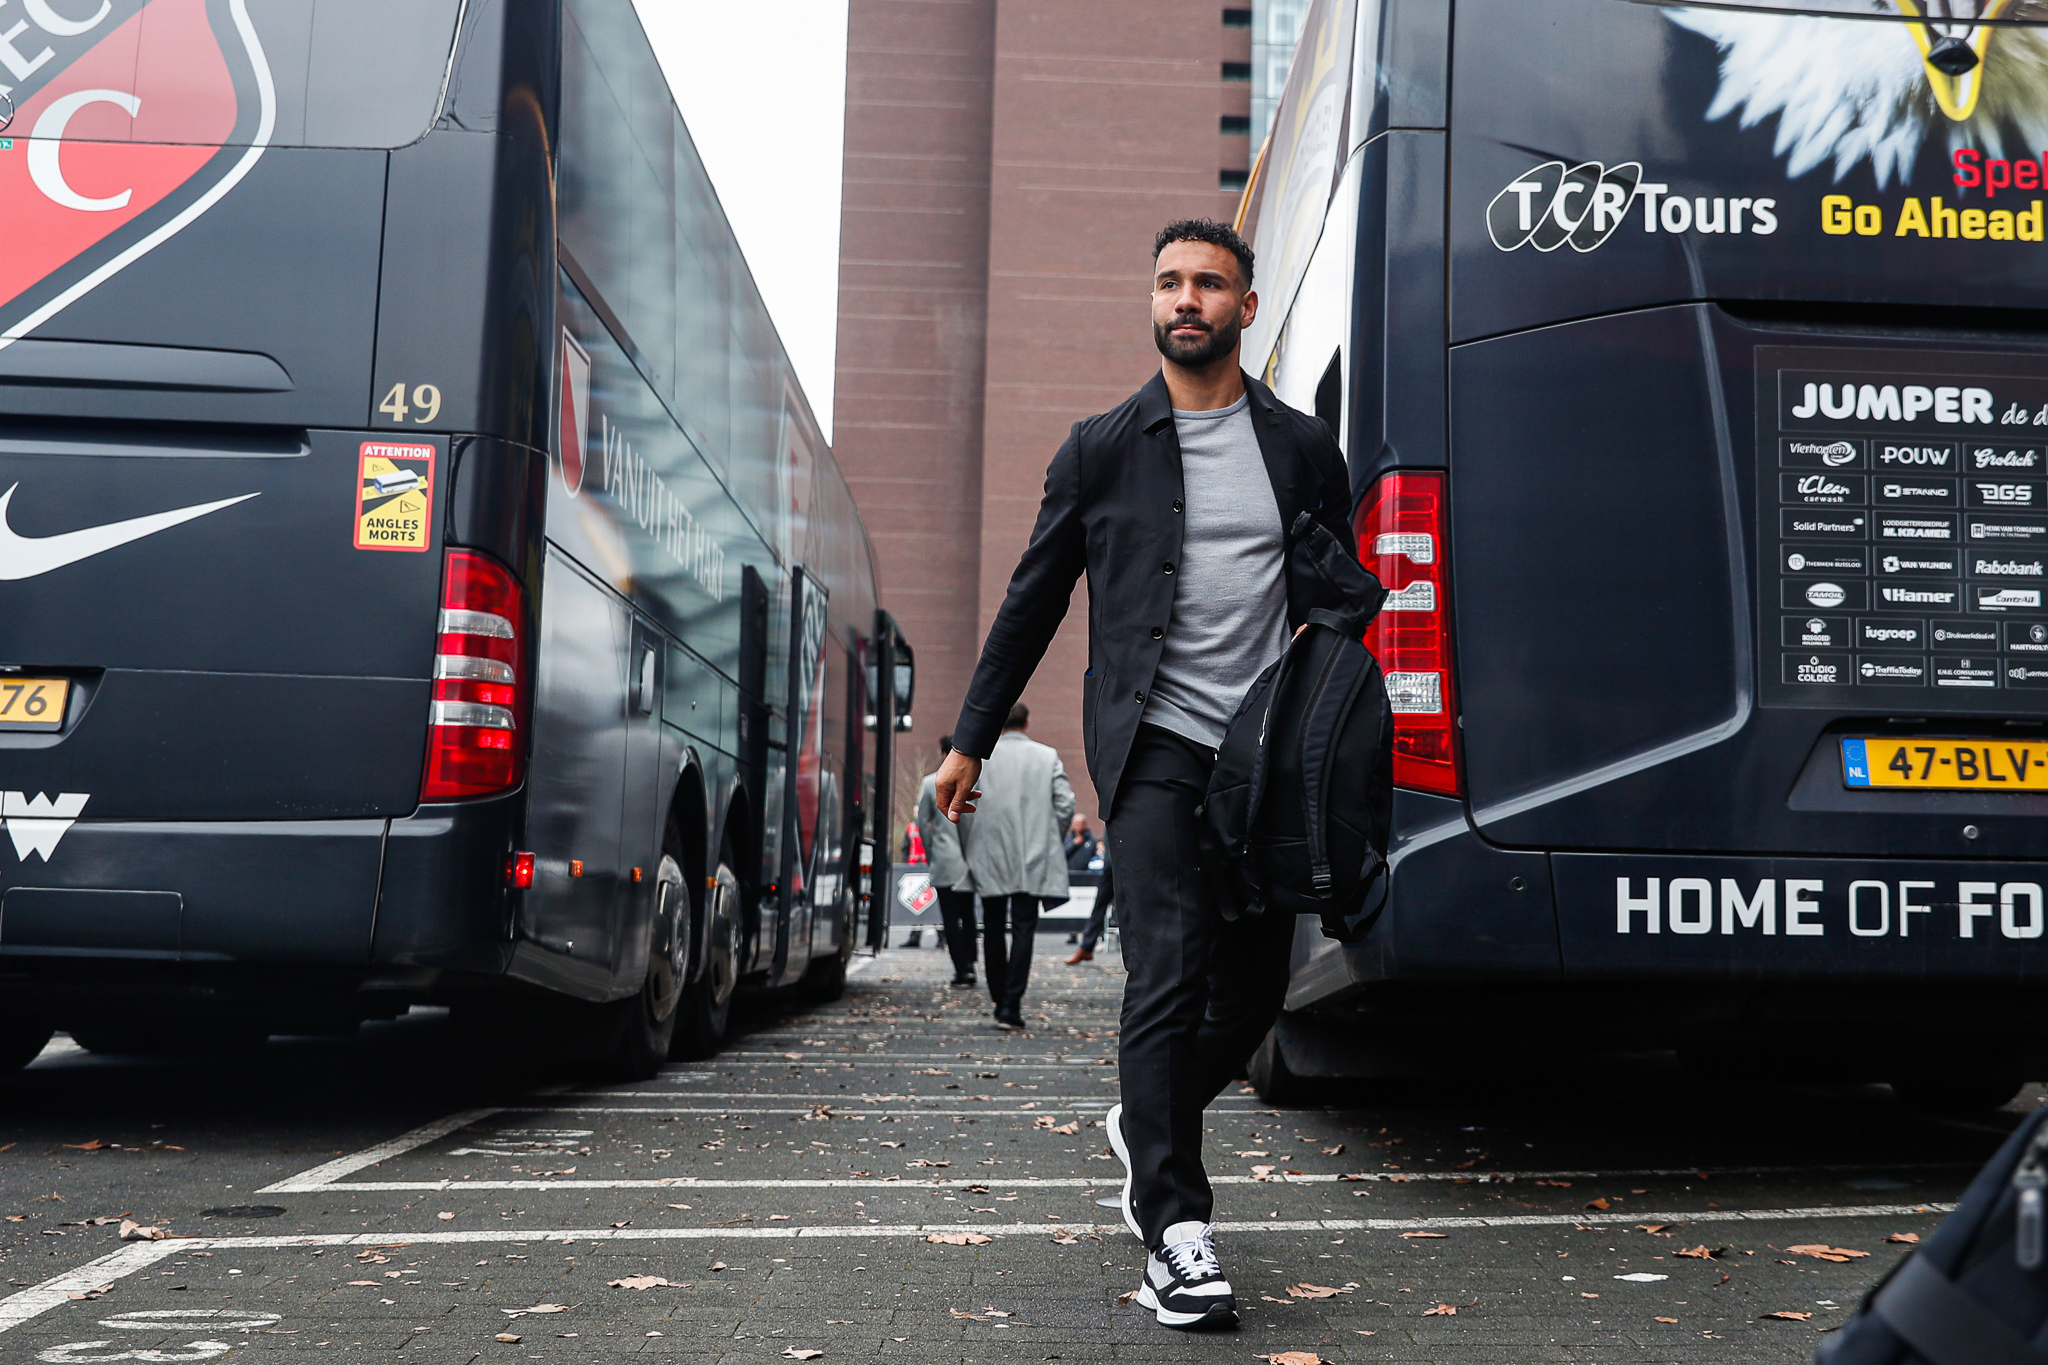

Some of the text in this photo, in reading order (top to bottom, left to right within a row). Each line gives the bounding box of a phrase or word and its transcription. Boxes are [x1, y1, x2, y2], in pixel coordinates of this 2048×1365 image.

[1953, 148, 2048, 198] Spel
[1508, 182, 1778, 235] TCR Tours
[1821, 194, 2044, 241] Go Ahead
[379, 382, 442, 424] 49
[1792, 382, 1994, 424] JUMPER
[2001, 402, 2029, 425] de
[364, 445, 431, 458] ATTENTION
[1880, 446, 1951, 466] POUW
[1974, 448, 2035, 468] Grolsch
[1797, 475, 1851, 494] iClean
[1902, 487, 1949, 497] STANNO
[602, 413, 726, 604] VANUIT HET HART
[367, 518, 419, 530] ANGLES
[1793, 521, 1856, 532] Solid Partners
[368, 530, 415, 541] MORTS
[1975, 559, 2043, 575] Rabobank
[1807, 591, 1843, 599] TAMOIL
[1891, 588, 1955, 603] Hamer
[1865, 625, 1917, 641] iugroep
[1797, 665, 1837, 674] STUDIO
[1797, 674, 1837, 682] COLDEC
[1, 685, 46, 716] 76
[1889, 746, 2048, 781] 47-BLV-
[1849, 767, 1866, 778] NL
[1616, 877, 2044, 938] HOME OF FO
